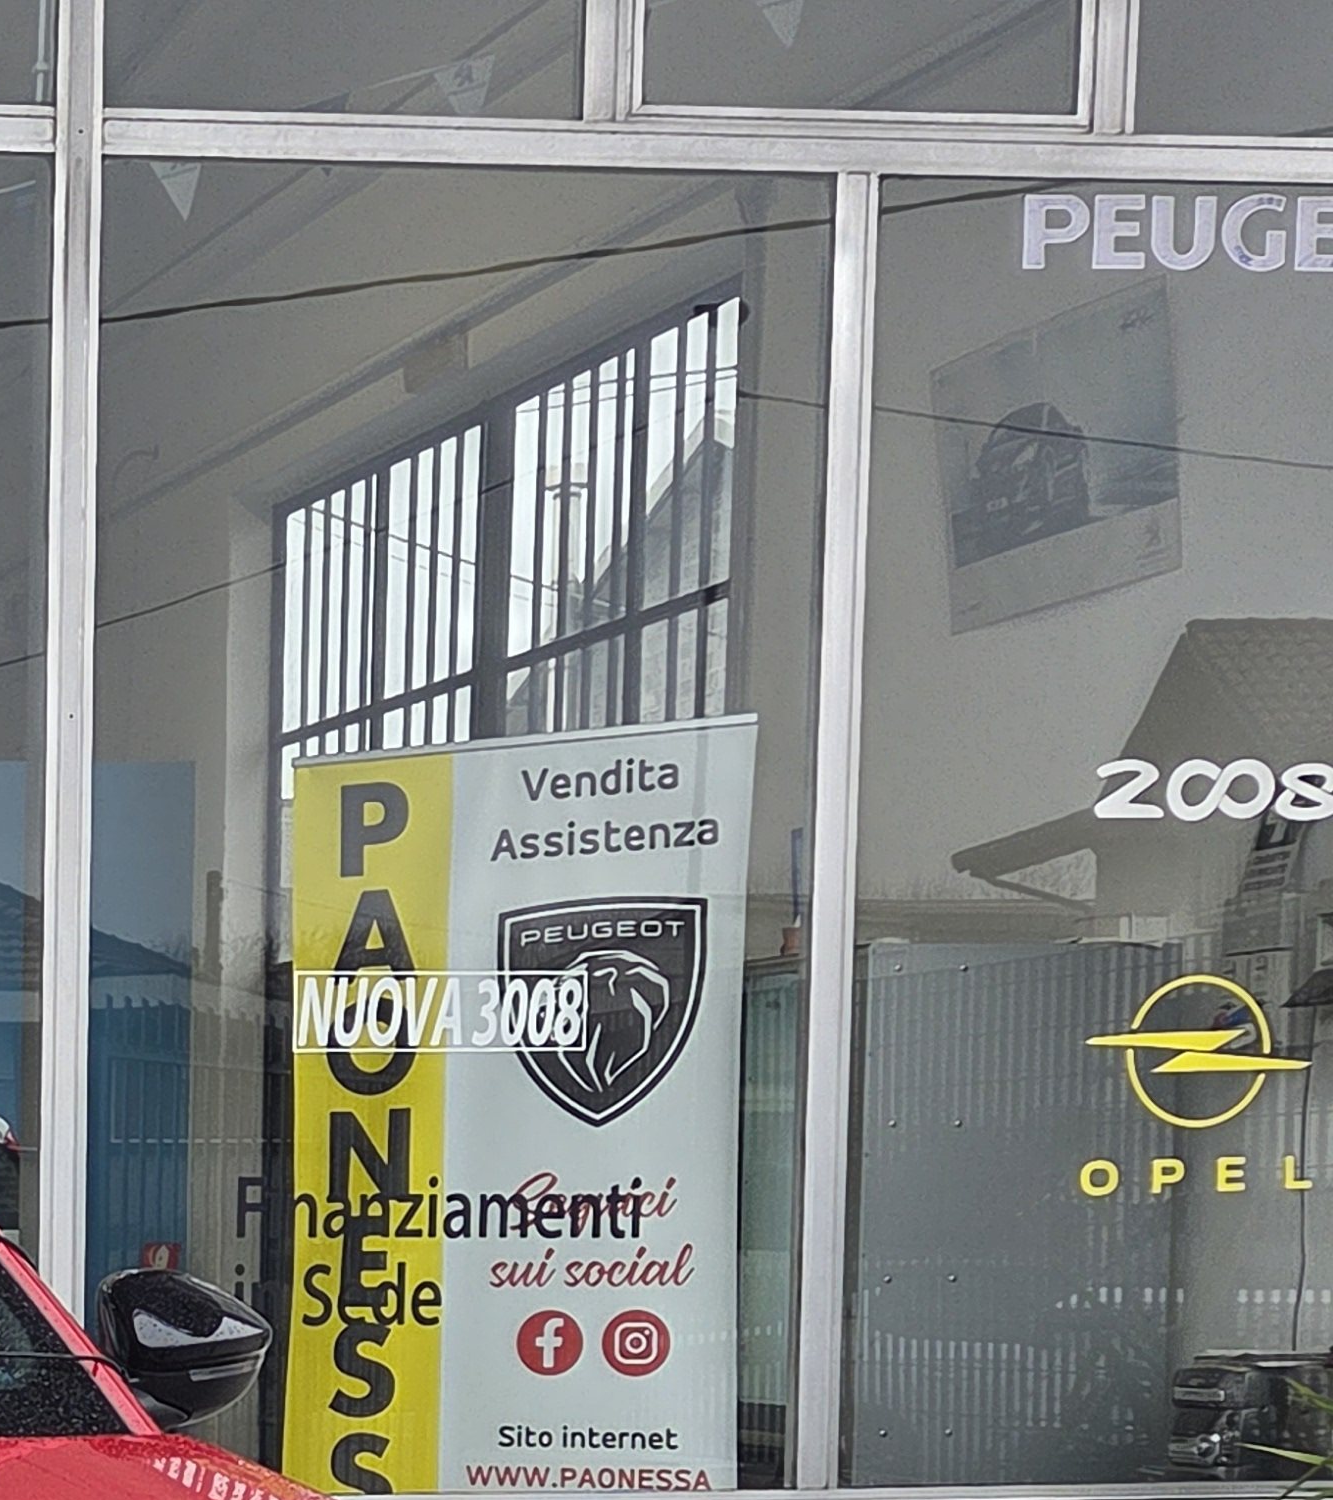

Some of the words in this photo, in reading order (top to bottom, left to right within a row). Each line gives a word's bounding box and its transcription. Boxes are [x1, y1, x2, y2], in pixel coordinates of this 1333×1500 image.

[1022, 193, 1333, 272] PEUGE
[522, 756, 680, 802] Vendita
[1094, 758, 1333, 821] 2008
[490, 814, 721, 863] Assistenza
[519, 920, 686, 947] PEUGEOT
[298, 977, 461, 1046] NUOVA
[471, 978, 583, 1046] 3008
[1079, 1155, 1313, 1197] OPEL
[488, 1248, 557, 1289] sui
[562, 1242, 695, 1289] social
[302, 1261, 443, 1327] Sede
[498, 1425, 553, 1448] Sito
[562, 1425, 679, 1450] internet
[465, 1464, 712, 1491] WWW.PAONESSA
